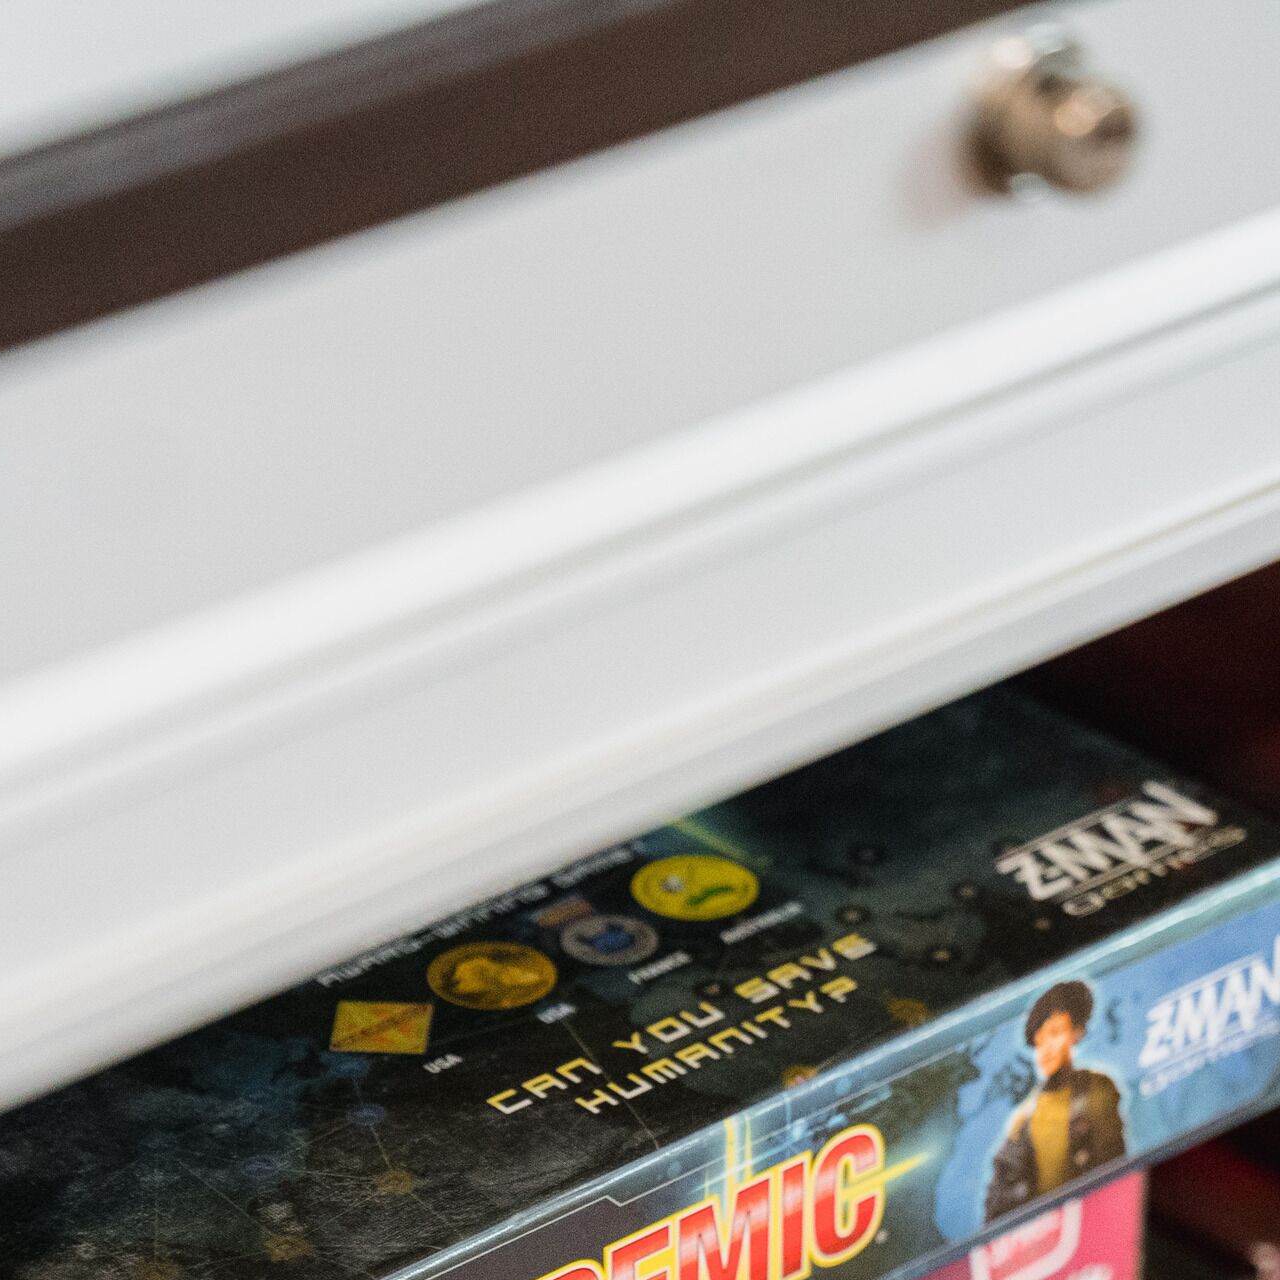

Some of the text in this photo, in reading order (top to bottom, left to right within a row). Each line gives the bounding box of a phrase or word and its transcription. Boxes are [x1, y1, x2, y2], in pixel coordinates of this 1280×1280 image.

[422, 1053, 464, 1076] USA
[486, 932, 878, 1115] CAN YOU SAVE
[574, 974, 858, 1114] HUMANITY?
